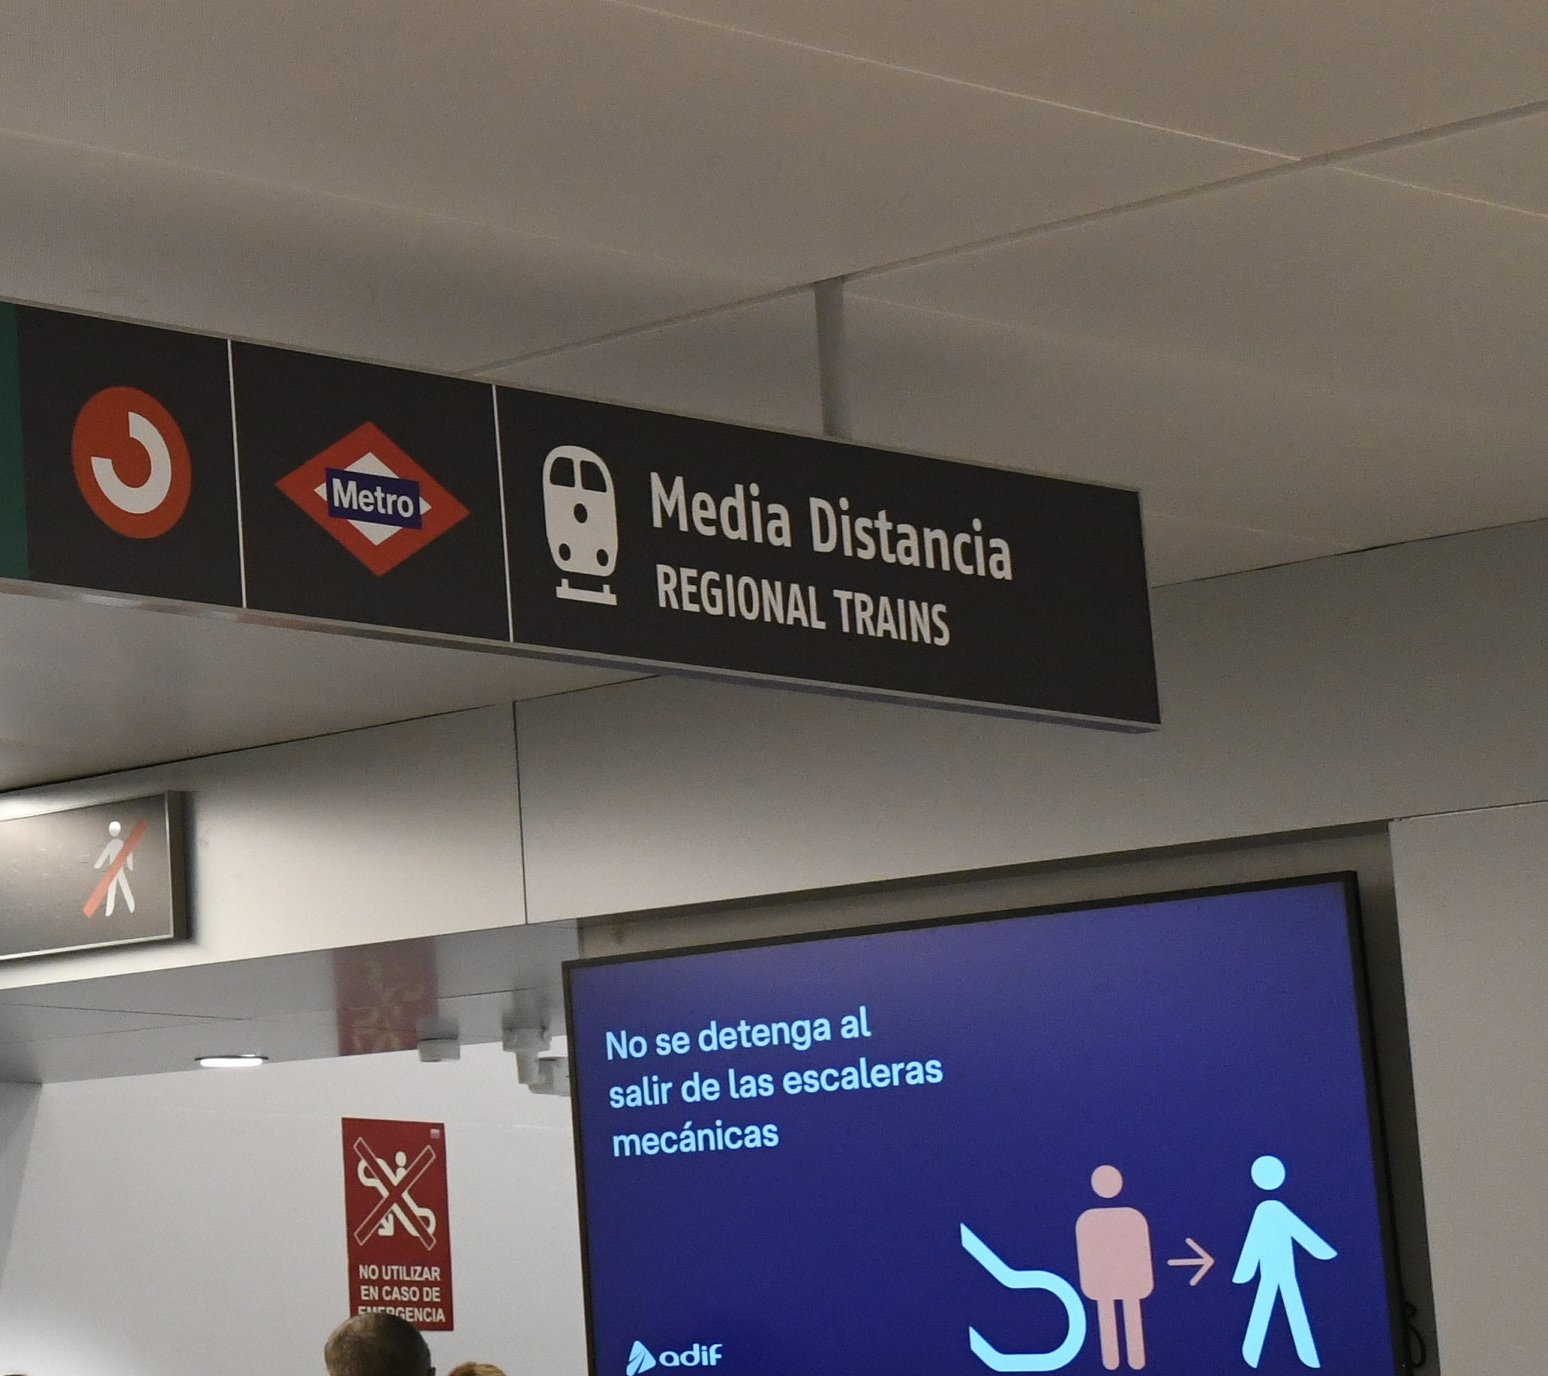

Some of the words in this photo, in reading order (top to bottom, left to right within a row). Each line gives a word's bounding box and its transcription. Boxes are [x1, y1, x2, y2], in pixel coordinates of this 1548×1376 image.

[331, 477, 415, 518] Metro
[649, 470, 792, 547] Media
[810, 496, 1013, 582] Distancia
[655, 562, 826, 630] REGIONAL
[832, 588, 951, 647] TRAINS
[606, 1030, 647, 1061] No
[656, 1031, 690, 1056] se
[698, 1017, 832, 1051] detenga
[840, 1005, 872, 1039] al
[609, 1075, 673, 1108] salir
[681, 1071, 720, 1103] de
[728, 1068, 774, 1099] las
[782, 1057, 944, 1095] escaleras
[612, 1118, 780, 1157] mecánicas
[358, 1264, 379, 1280] NO
[382, 1265, 441, 1281] UTILIZAR
[360, 1285, 379, 1300] EN
[382, 1286, 420, 1301] CASO
[422, 1287, 441, 1302] DE
[658, 1343, 723, 1367] adif
